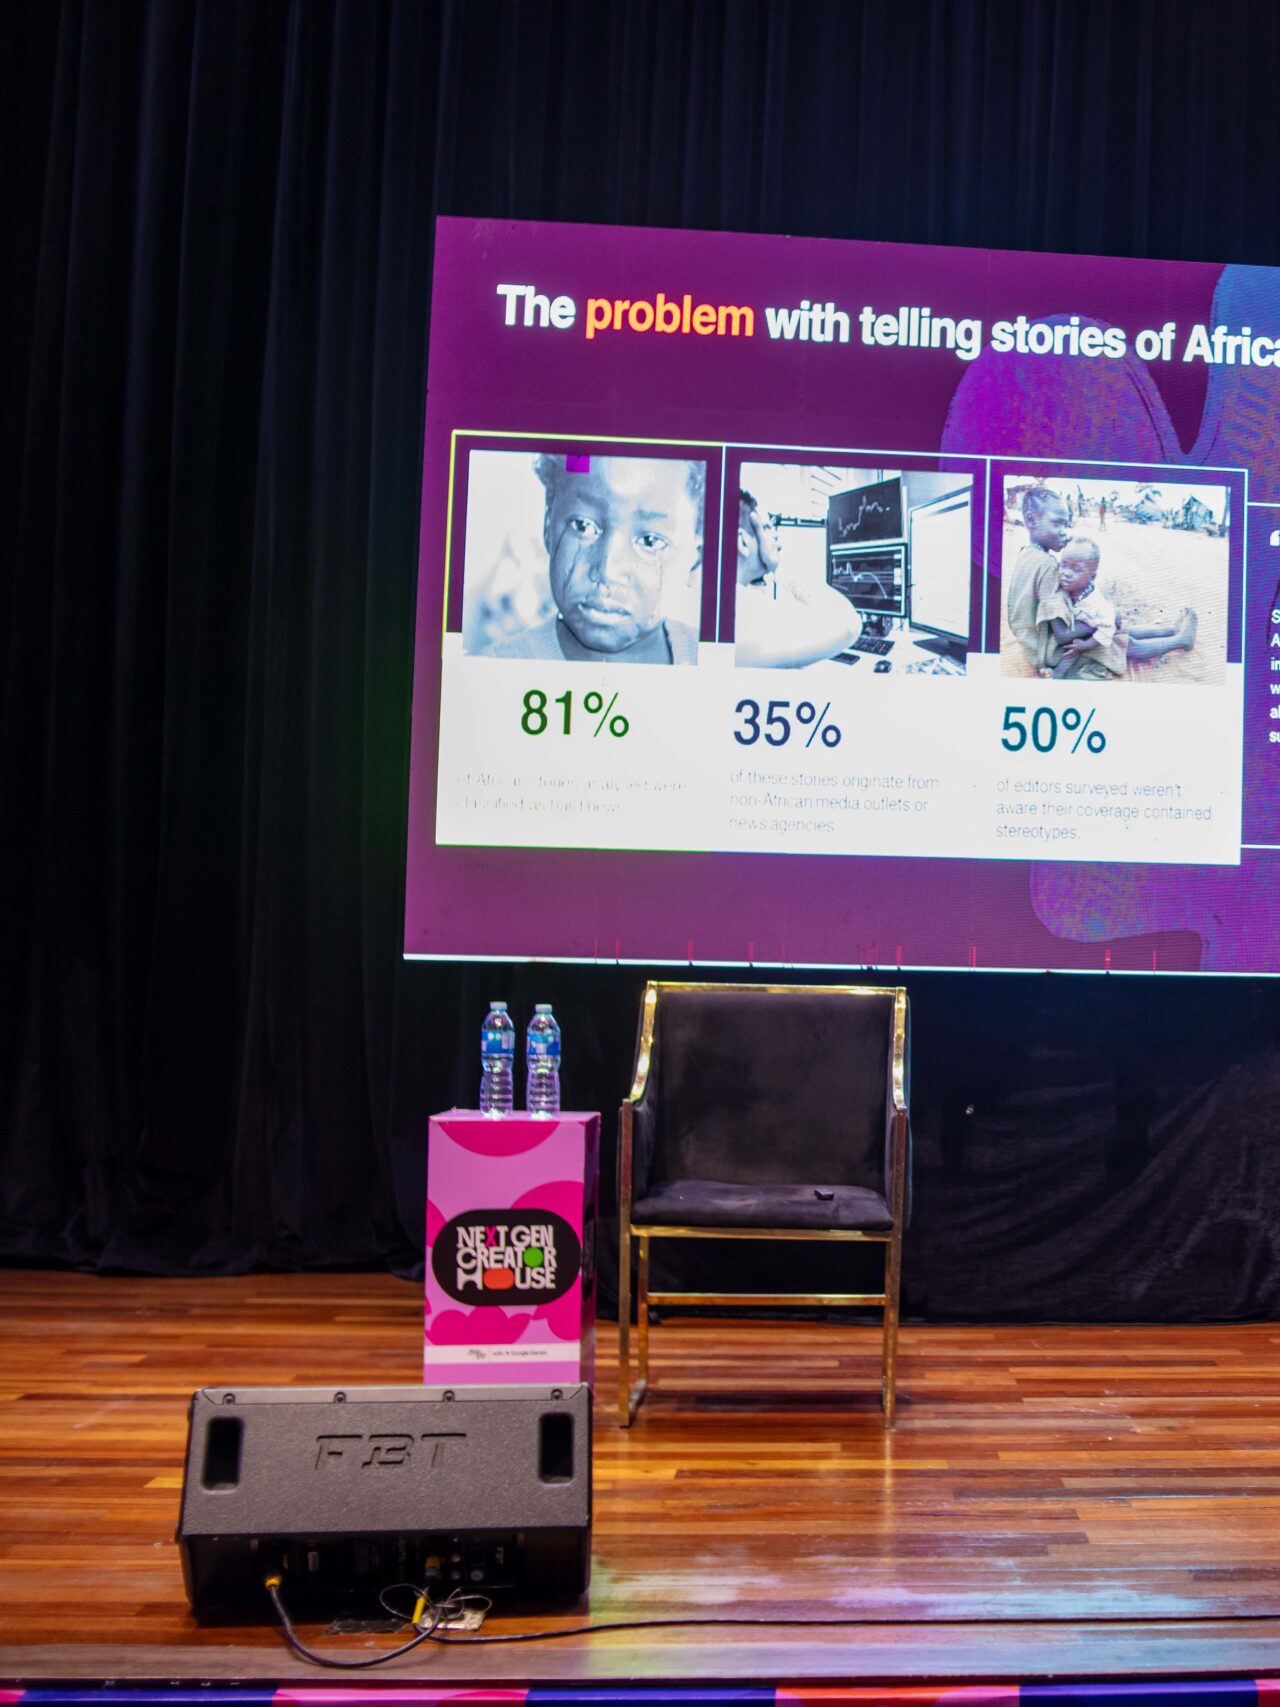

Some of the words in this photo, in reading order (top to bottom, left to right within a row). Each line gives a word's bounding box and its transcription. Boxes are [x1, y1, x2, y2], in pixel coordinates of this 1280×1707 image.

[496, 283, 575, 329] The
[586, 293, 755, 339] problem
[765, 301, 850, 343] with
[860, 306, 982, 360] telling
[991, 316, 1127, 358] stories
[1135, 322, 1176, 361] of
[520, 690, 629, 737] 81%
[734, 699, 841, 748] 35%
[1001, 706, 1106, 754] 50%
[730, 769, 744, 784] of
[747, 770, 788, 786] these
[791, 773, 838, 788] stories
[842, 775, 904, 792] originate
[907, 774, 939, 789] from
[997, 778, 1010, 793] of
[1014, 779, 1061, 794] editors
[1066, 781, 1128, 799] surveyed
[730, 792, 813, 809] non-African
[815, 796, 860, 810] media
[863, 796, 911, 812] outlets
[914, 800, 928, 812] or
[996, 802, 1037, 816] aware
[1042, 802, 1072, 816] their
[1076, 805, 1139, 821] coverage
[1143, 805, 1212, 821] contained
[728, 817, 767, 831] news
[996, 825, 1080, 841] stereotypes.
[456, 1225, 509, 1248] NEXT
[510, 1225, 554, 1248] GEN
[456, 1246, 558, 1270] CREATOR
[456, 1267, 556, 1290] HOUSE
[315, 1433, 467, 1470] FBT
